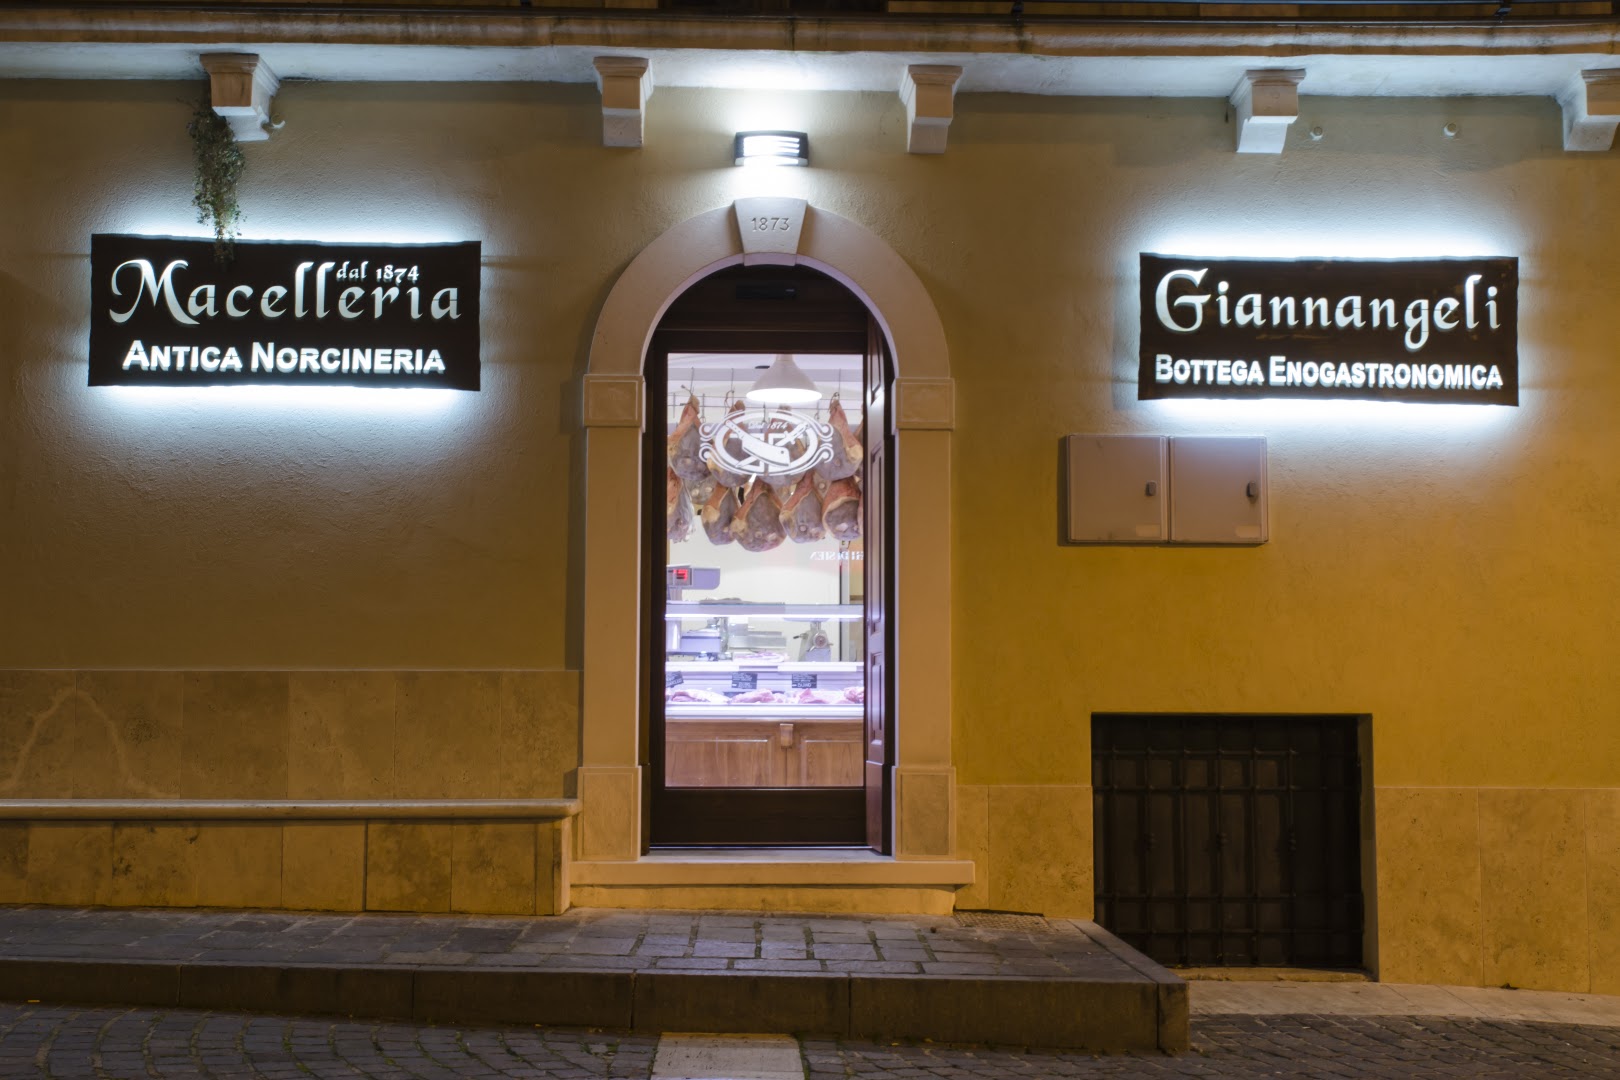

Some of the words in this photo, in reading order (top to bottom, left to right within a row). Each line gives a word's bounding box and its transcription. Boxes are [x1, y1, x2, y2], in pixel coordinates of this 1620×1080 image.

[751, 217, 790, 231] 1873
[336, 261, 369, 280] dal
[375, 264, 420, 284] 1874
[109, 258, 462, 325] Macelleria
[1154, 267, 1501, 351] Giannangeli
[122, 339, 243, 372] ANTICA
[250, 341, 447, 374] NORCINERIA
[1154, 353, 1265, 386] BOTTEGA
[1268, 355, 1504, 391] ENOGASTRONOMICA
